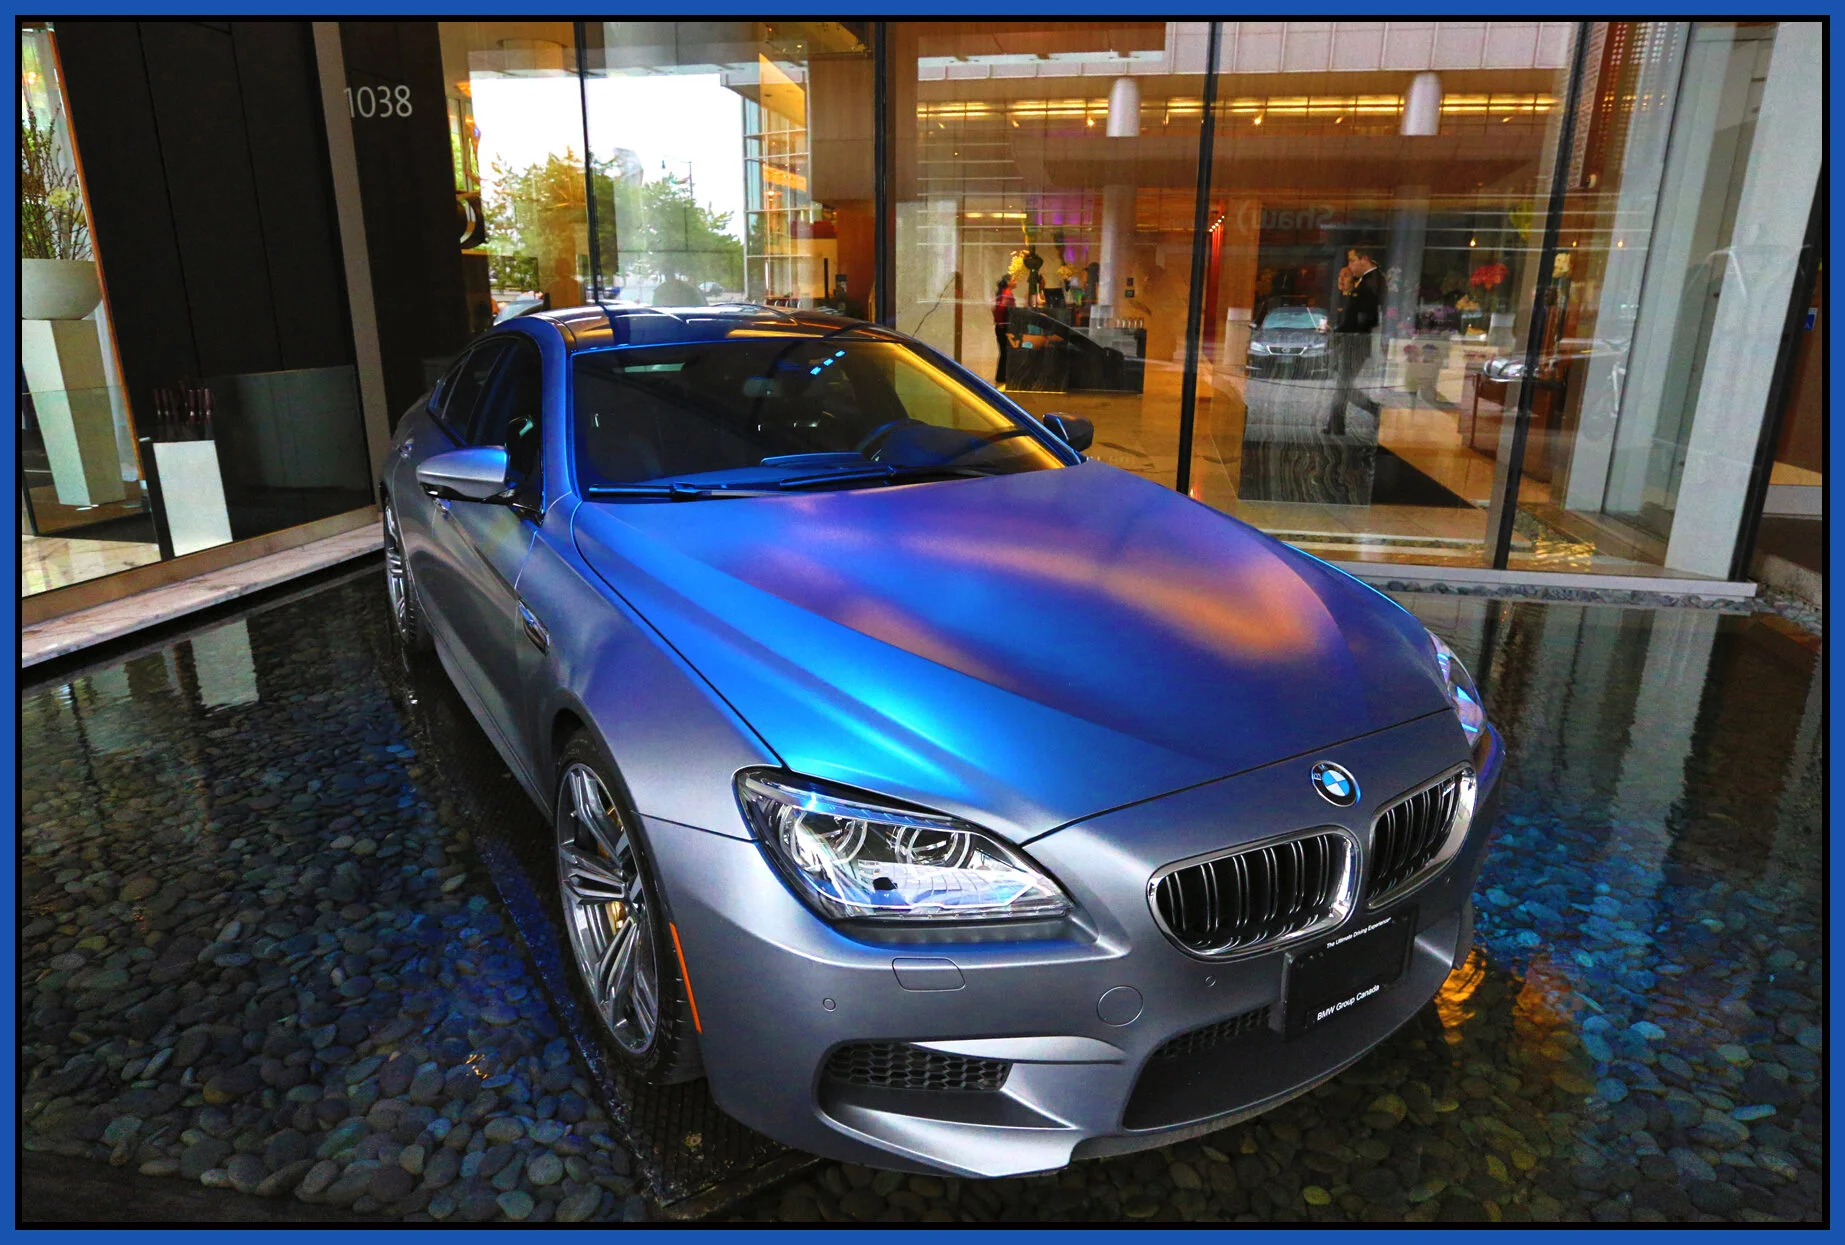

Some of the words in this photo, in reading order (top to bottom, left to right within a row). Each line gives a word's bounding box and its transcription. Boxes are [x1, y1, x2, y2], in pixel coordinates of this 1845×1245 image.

[343, 85, 412, 118] 1038
[1335, 934, 1353, 945] Ultimate
[1353, 928, 1368, 938] Driving
[1317, 1005, 1336, 1021] BMW
[1336, 997, 1356, 1011] Group
[1356, 984, 1380, 1001] Canada
